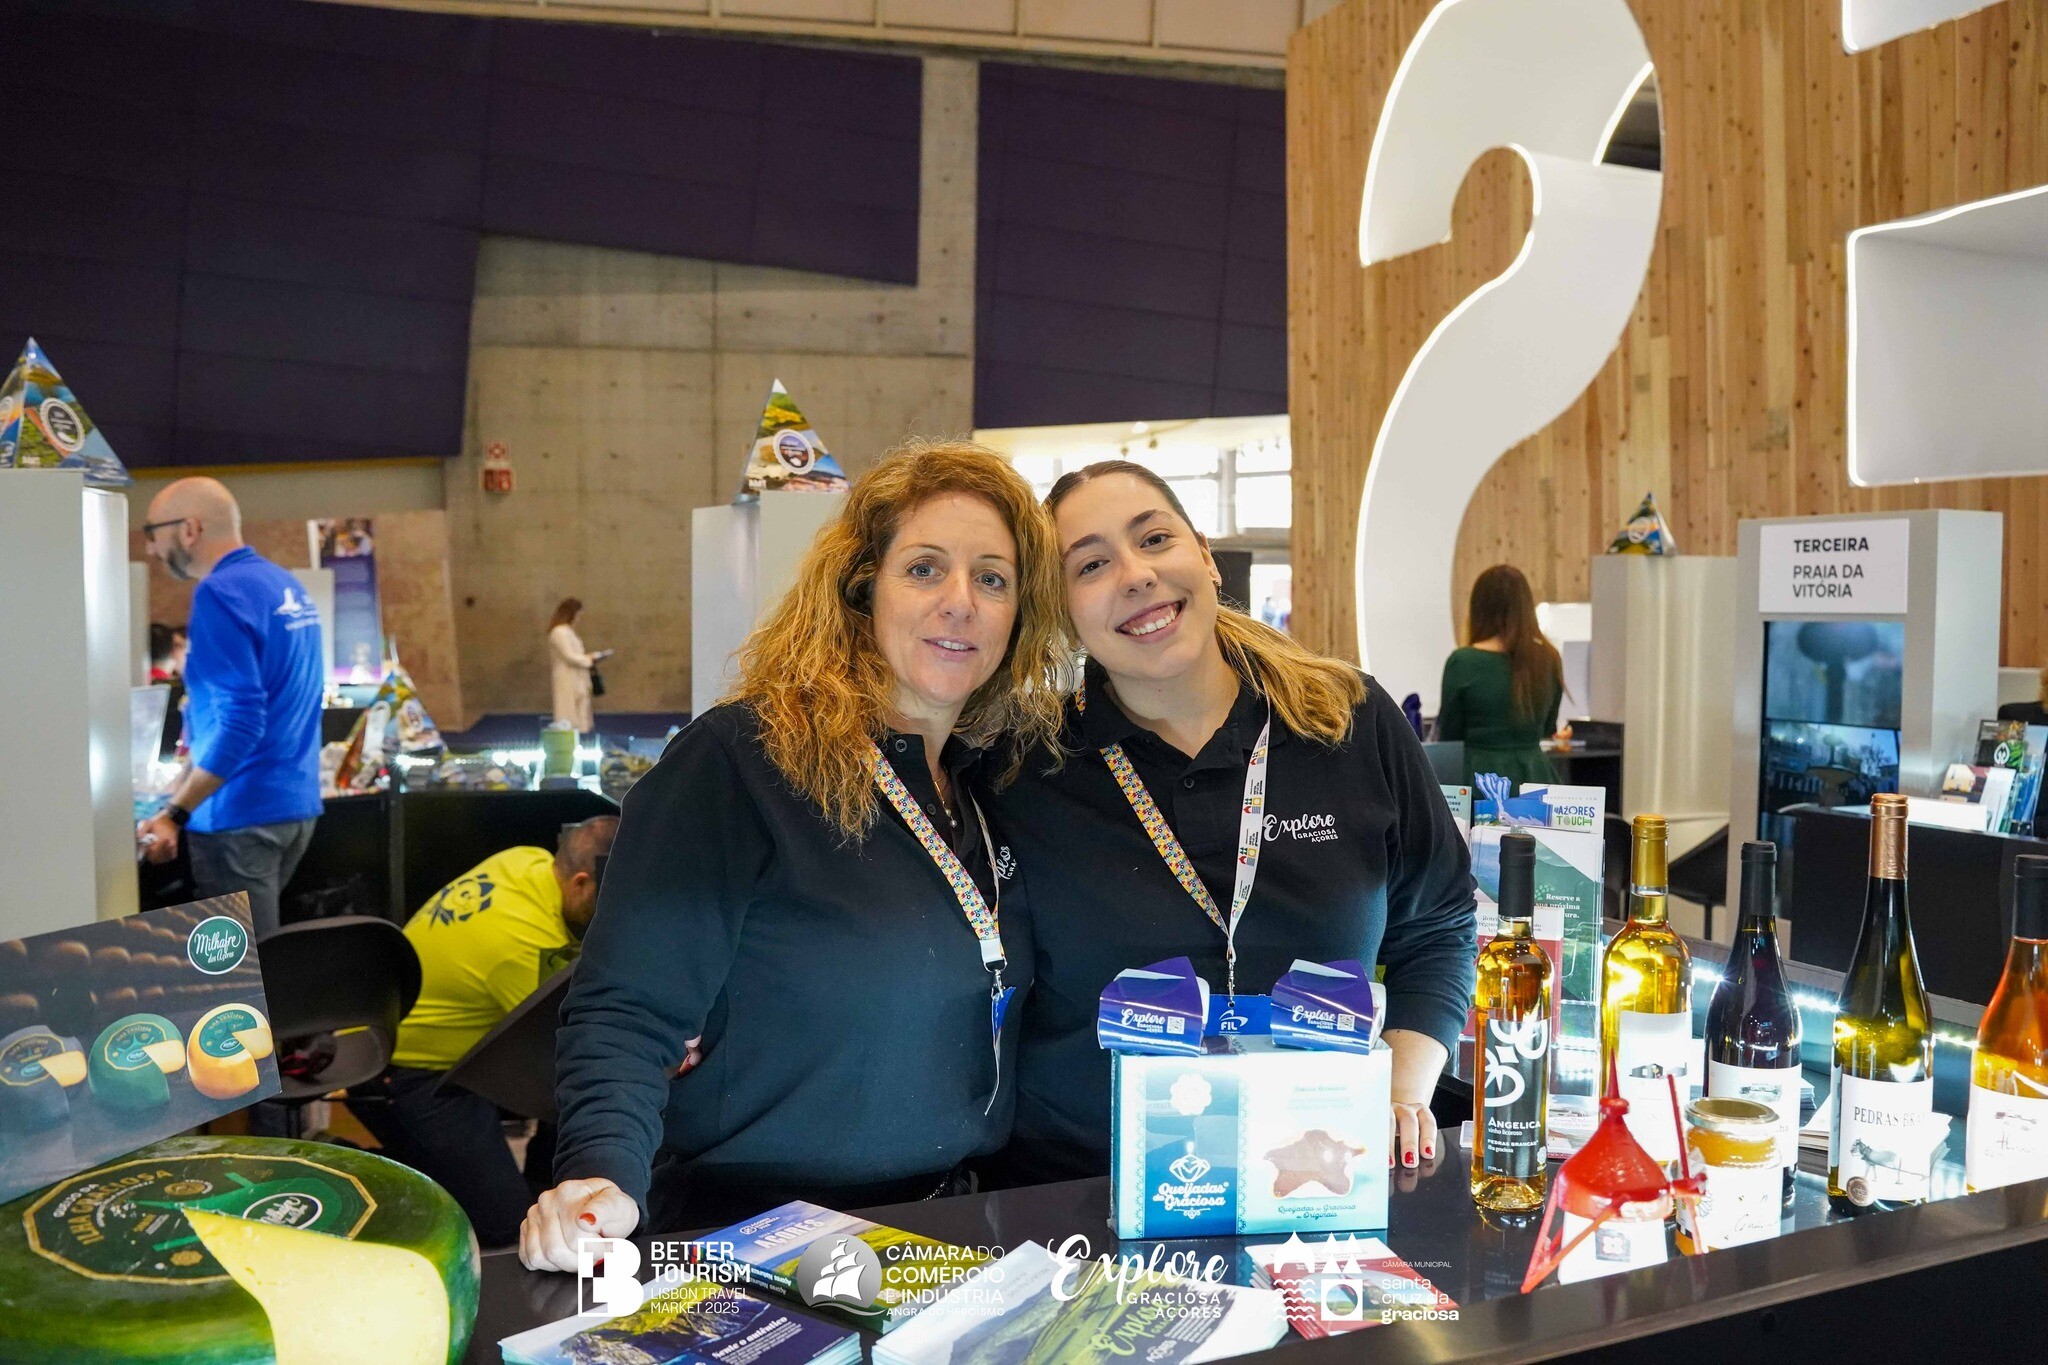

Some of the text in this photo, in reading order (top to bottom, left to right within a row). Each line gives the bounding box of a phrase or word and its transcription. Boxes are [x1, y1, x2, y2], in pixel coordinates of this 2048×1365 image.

[1794, 537, 1869, 553] TERCEIRA
[1793, 564, 1864, 579] PRAIA DA
[1792, 580, 1852, 598] VITÓRIA
[1262, 813, 1336, 842] Explore
[1297, 828, 1337, 840] GRACIOSA
[1311, 834, 1339, 843] AÇORES
[1545, 893, 1575, 902] Reserve
[193, 929, 241, 956] Milhafre
[1121, 1008, 1166, 1027] Explore
[1292, 1005, 1336, 1025] Explore
[1220, 1021, 1238, 1031] FIL
[1854, 1106, 1899, 1127] PEDRAS
[1487, 1127, 1523, 1136] vinho licoroso
[1487, 1139, 1510, 1147] PEDRAS
[1164, 1194, 1227, 1211] Graciosa
[753, 1218, 827, 1250] AÇORES
